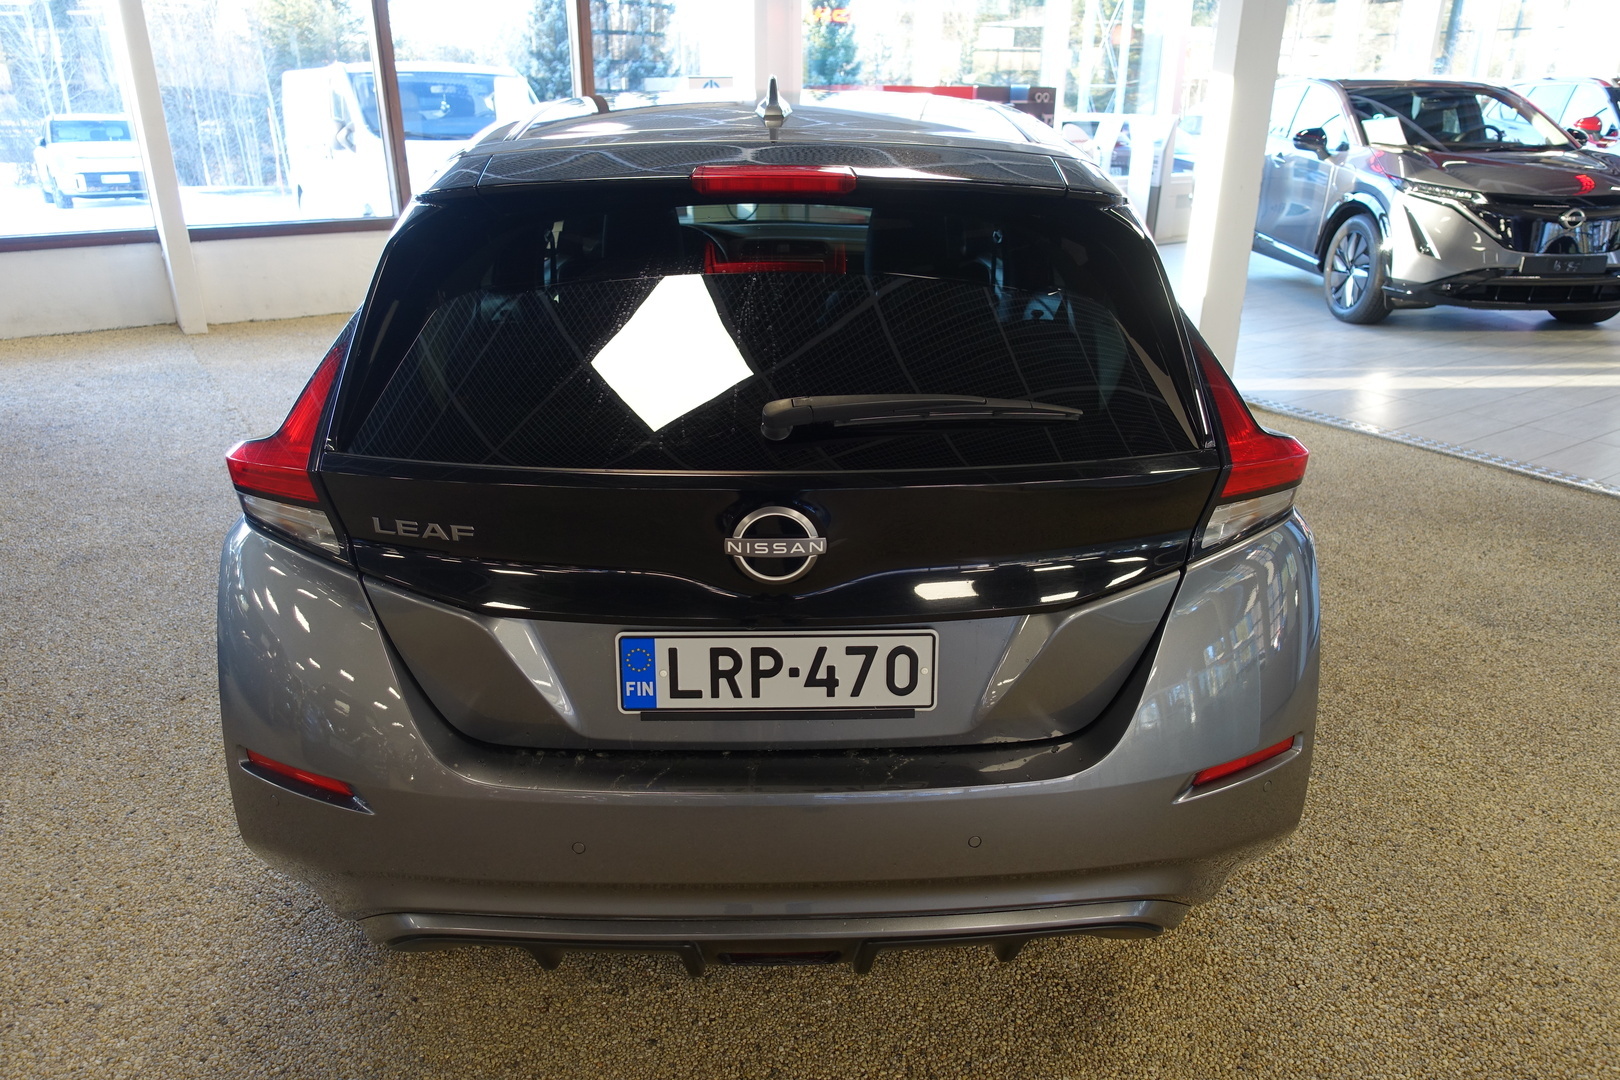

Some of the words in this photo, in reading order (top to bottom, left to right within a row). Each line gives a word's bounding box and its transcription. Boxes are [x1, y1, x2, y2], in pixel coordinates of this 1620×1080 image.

[371, 516, 475, 541] LEAF
[727, 541, 824, 554] NISSAN
[625, 681, 654, 697] FIN
